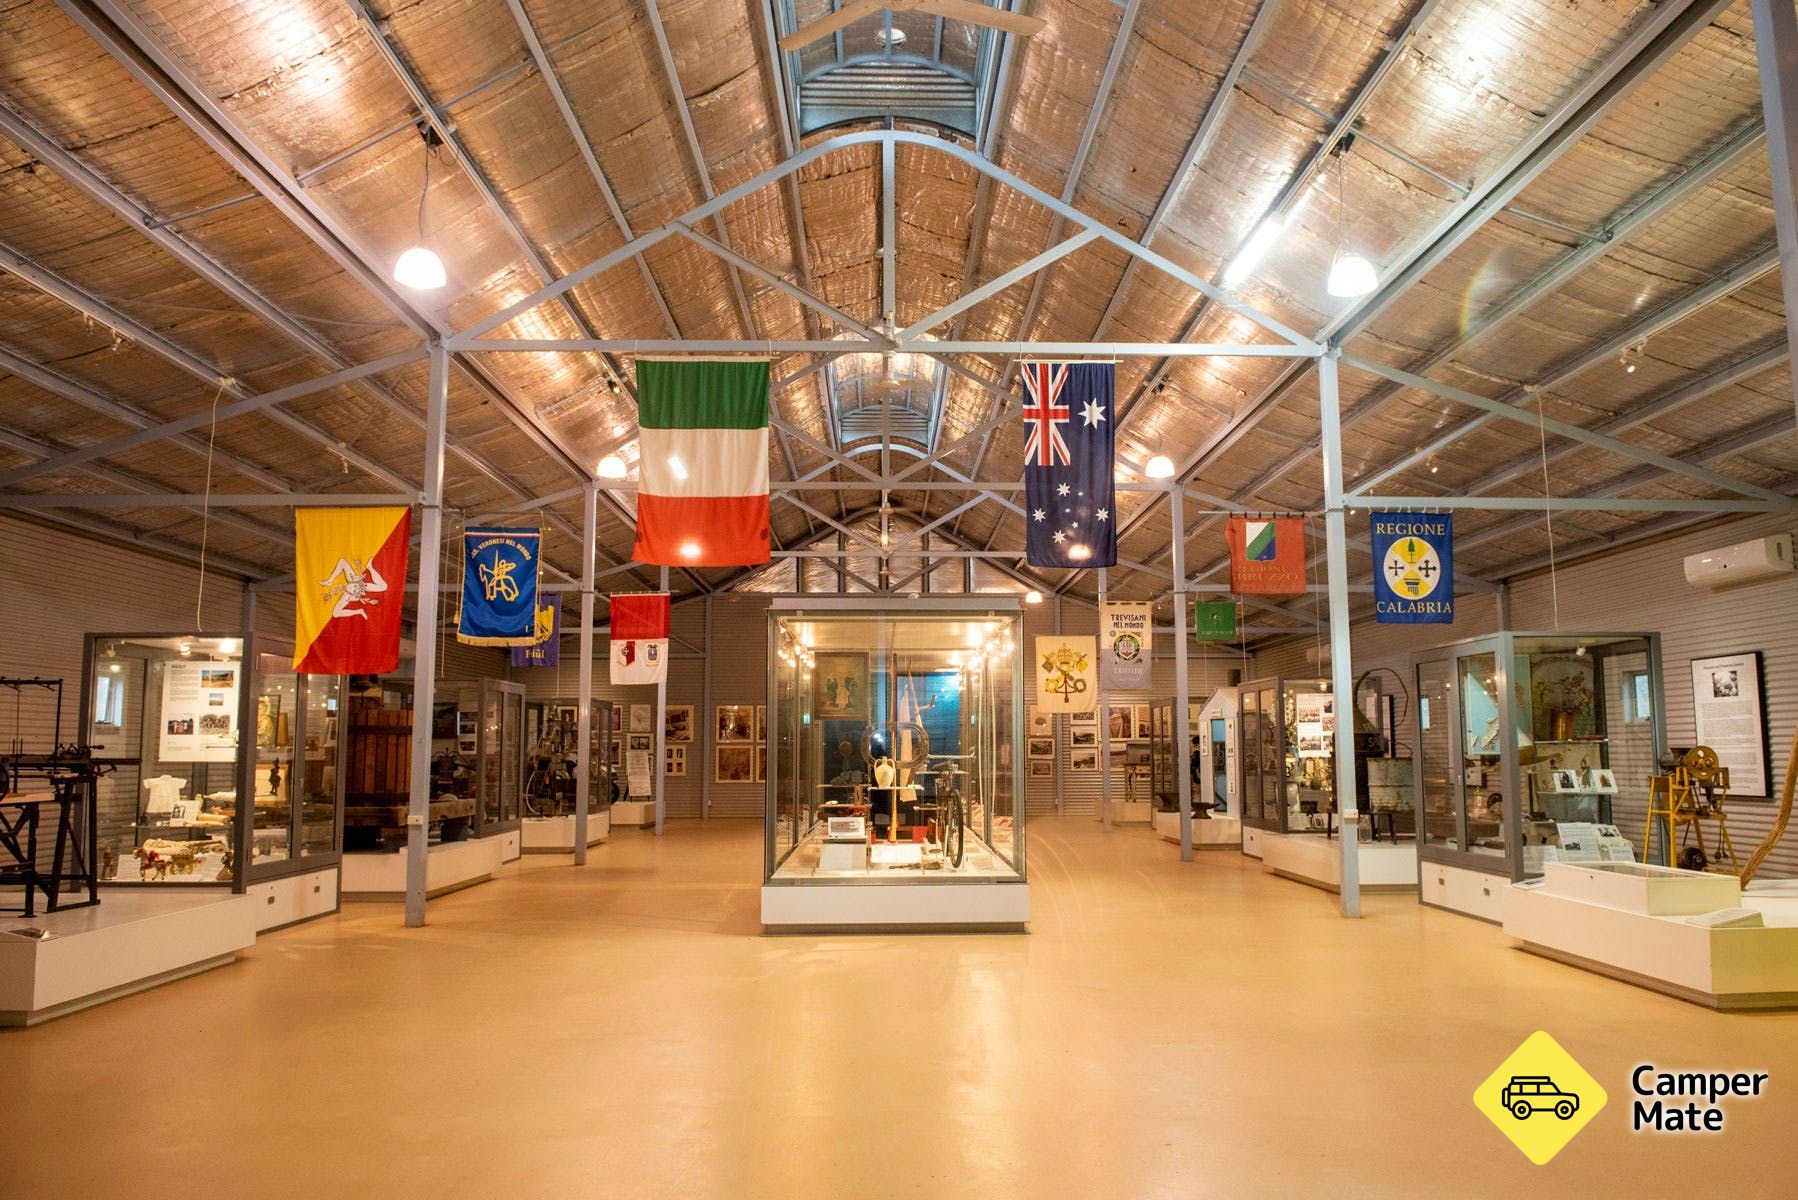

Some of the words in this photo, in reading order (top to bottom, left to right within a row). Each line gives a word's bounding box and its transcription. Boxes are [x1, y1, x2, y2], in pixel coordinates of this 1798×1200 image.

[1376, 523, 1445, 535] REGIONE
[506, 538, 516, 547] NEL
[1376, 601, 1452, 613] CALABRIA
